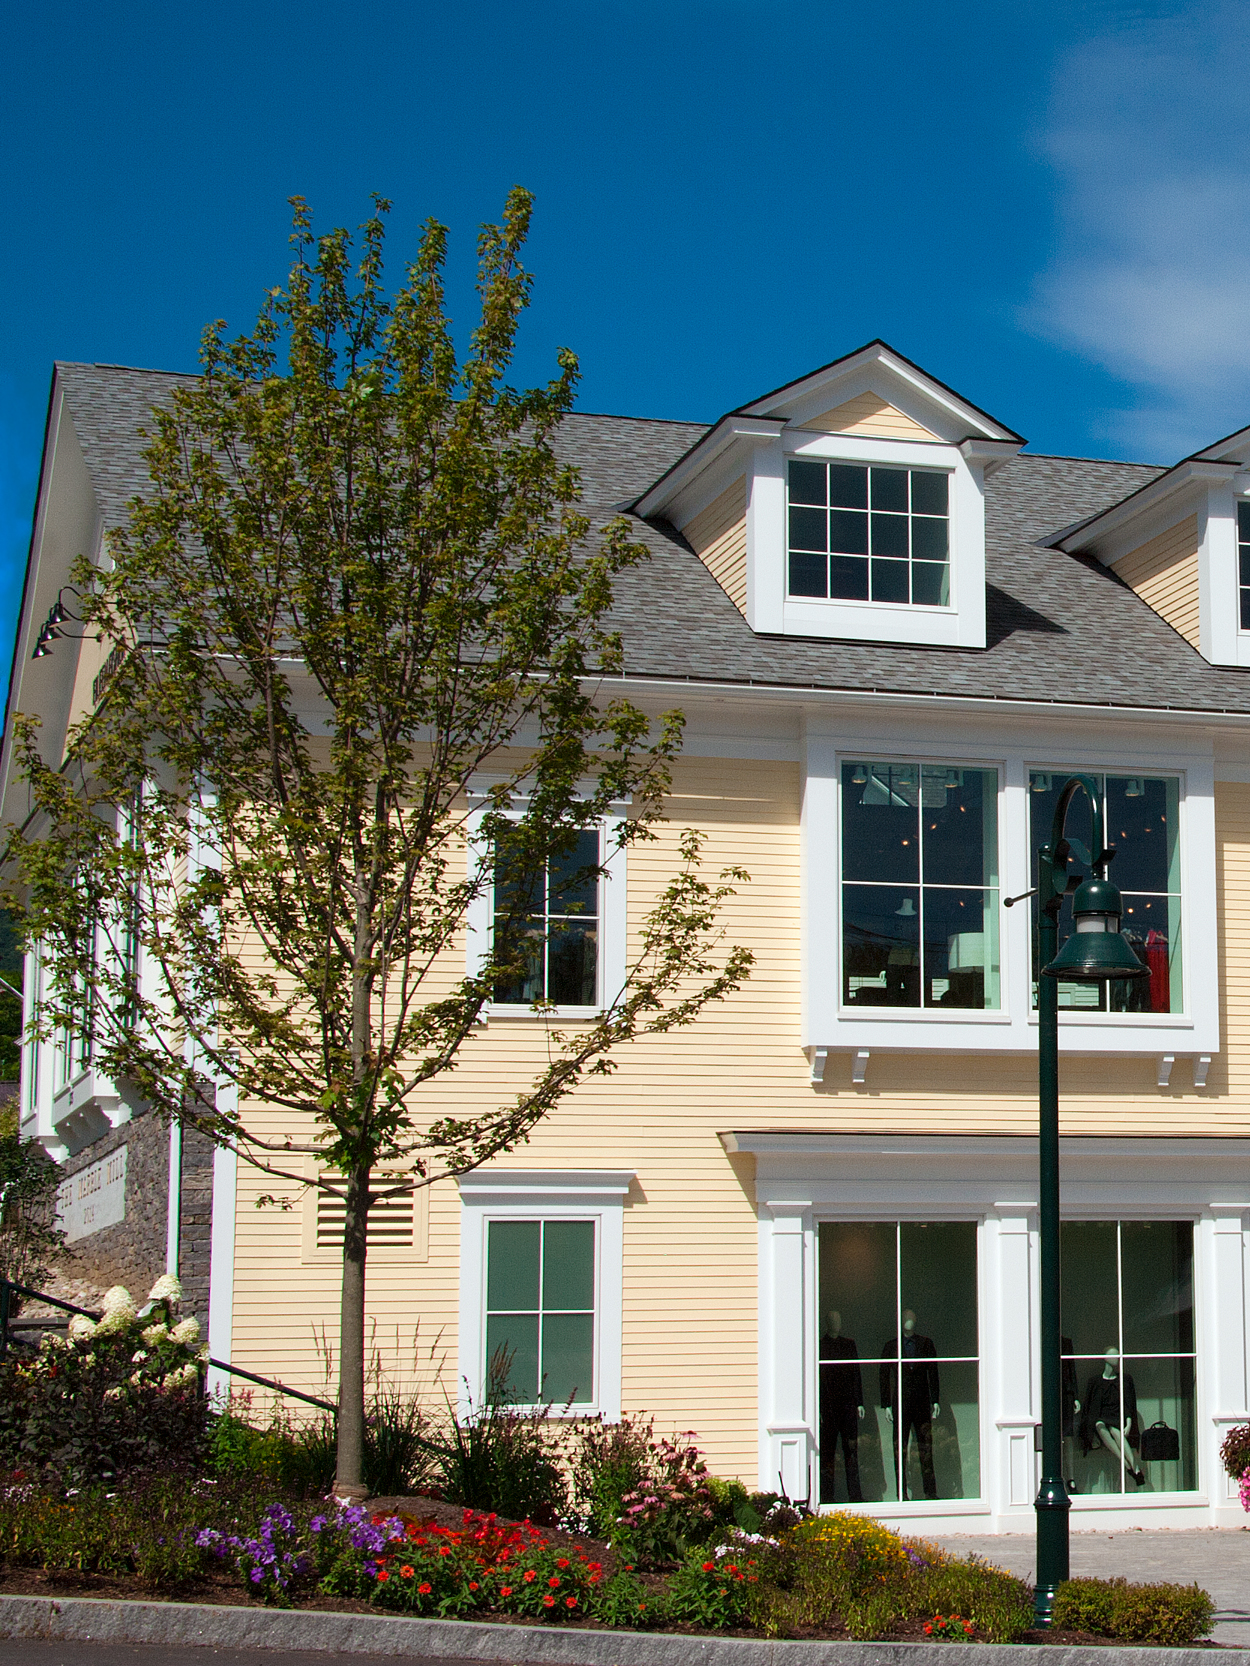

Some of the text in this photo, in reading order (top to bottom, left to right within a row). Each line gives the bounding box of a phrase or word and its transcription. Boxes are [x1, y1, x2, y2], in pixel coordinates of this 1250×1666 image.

[61, 1155, 123, 1209] THE MARBLE MILL
